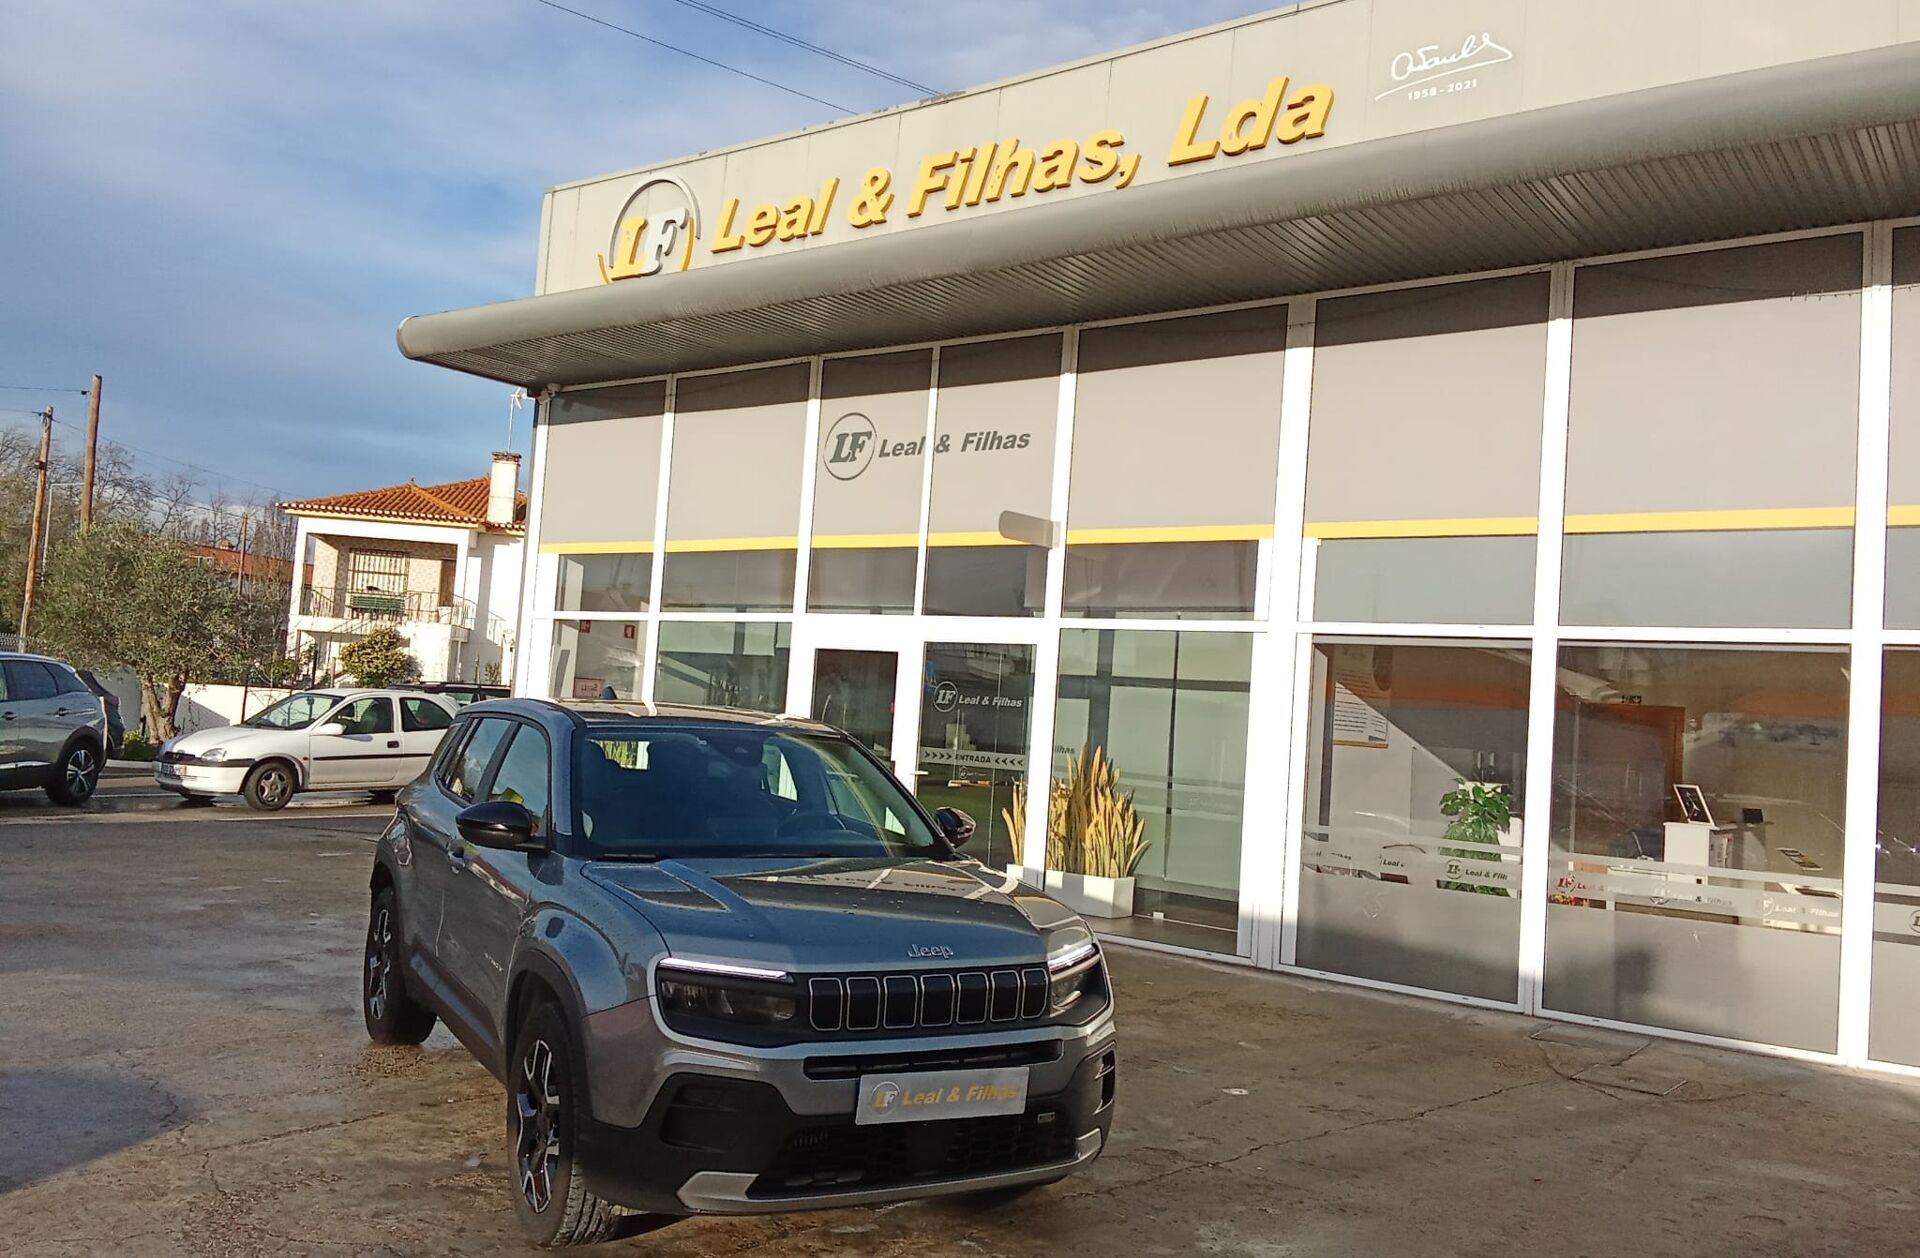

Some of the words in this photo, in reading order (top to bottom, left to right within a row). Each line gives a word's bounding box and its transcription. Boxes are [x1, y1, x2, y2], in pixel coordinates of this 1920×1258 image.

[711, 177, 840, 254] Leal
[848, 166, 895, 229] &
[906, 128, 1142, 217] Filhas,
[1168, 76, 1336, 167] Lda
[829, 431, 873, 463] LF
[879, 436, 926, 458] Leal
[934, 434, 951, 453] &
[961, 430, 1031, 453] Filhas
[959, 694, 979, 706] Leal
[981, 695, 989, 706] &
[992, 697, 1023, 709] Filhas
[955, 753, 992, 764] ENTRADA
[907, 944, 954, 960] Jeep
[902, 1088, 942, 1106] Leal
[946, 1086, 961, 1103] &
[966, 1083, 1018, 1101] Filhas
